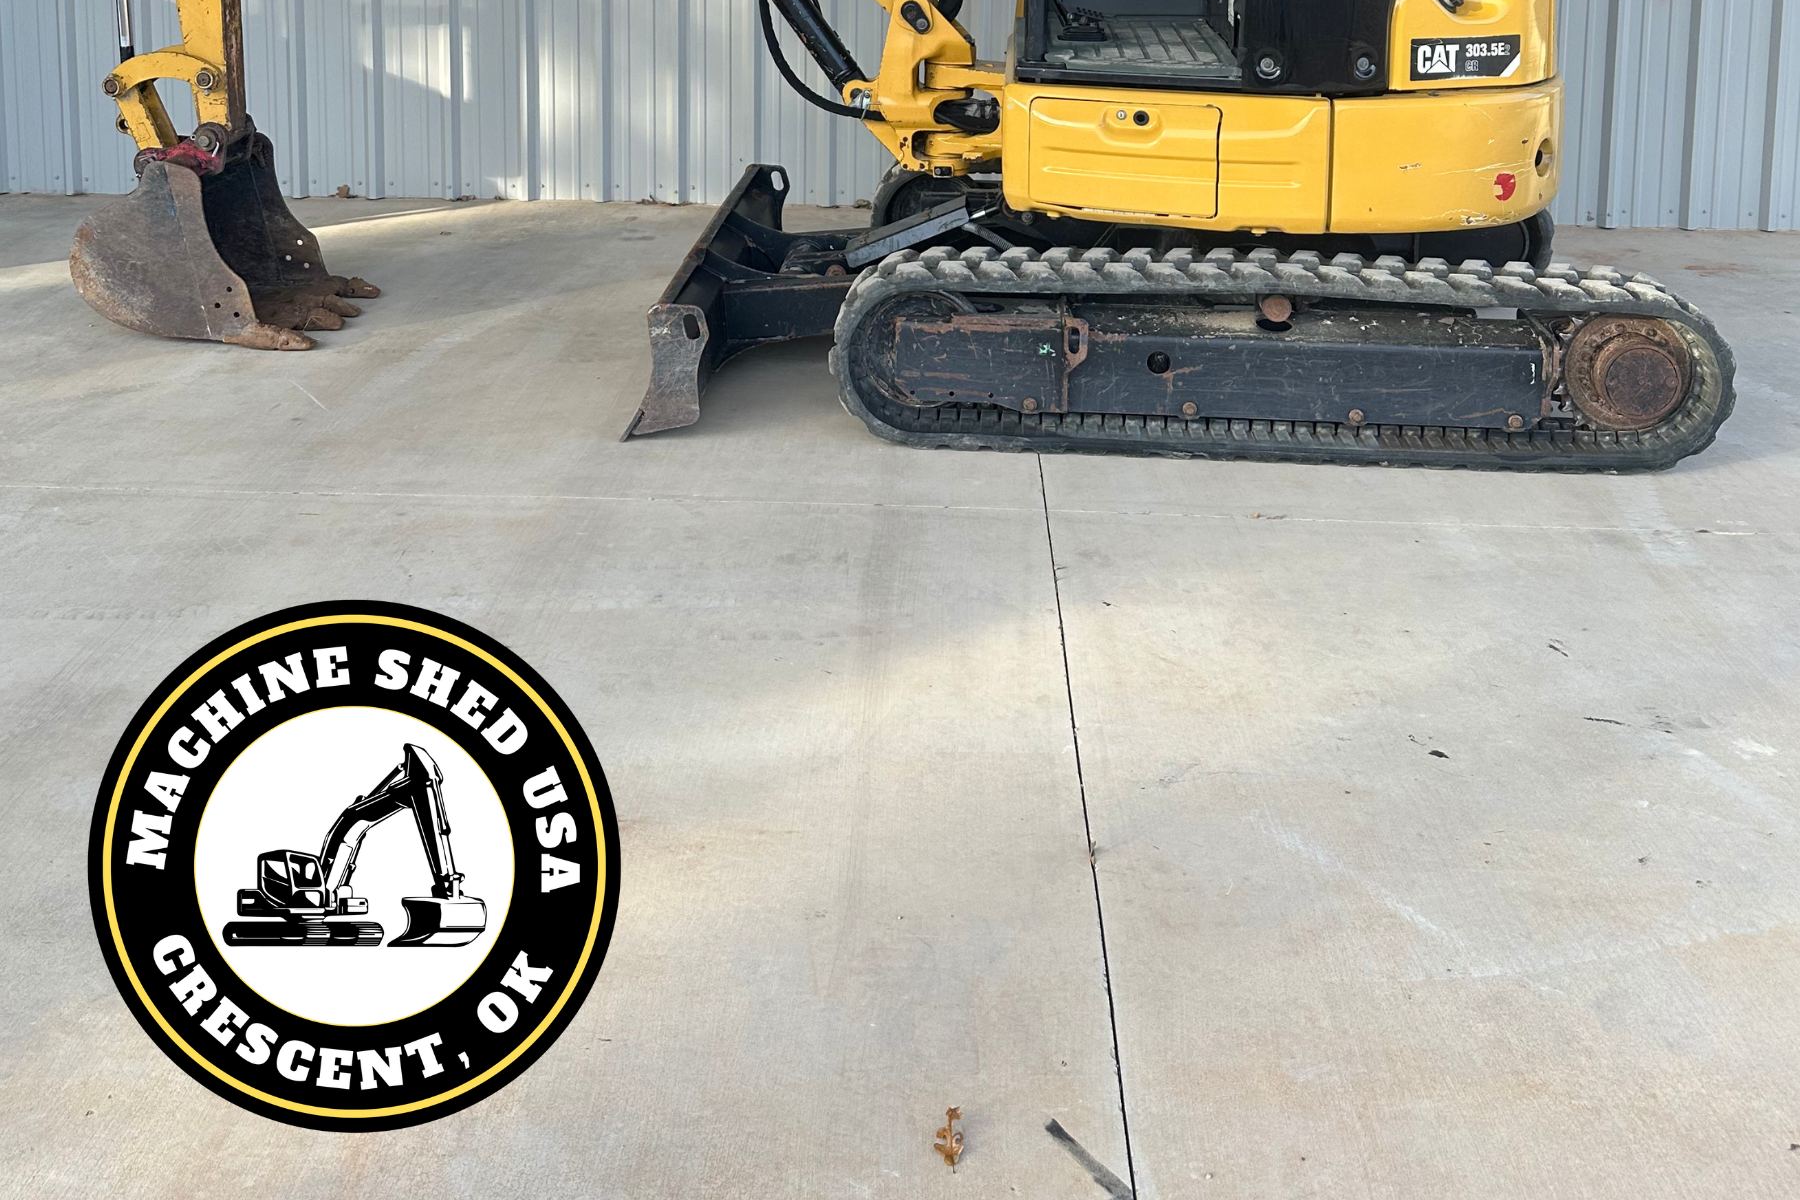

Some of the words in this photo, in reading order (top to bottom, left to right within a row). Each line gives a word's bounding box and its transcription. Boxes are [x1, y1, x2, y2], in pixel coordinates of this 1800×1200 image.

[1465, 42, 1511, 57] 303.5E2
[1417, 44, 1460, 74] CAT
[1465, 59, 1479, 71] CR
